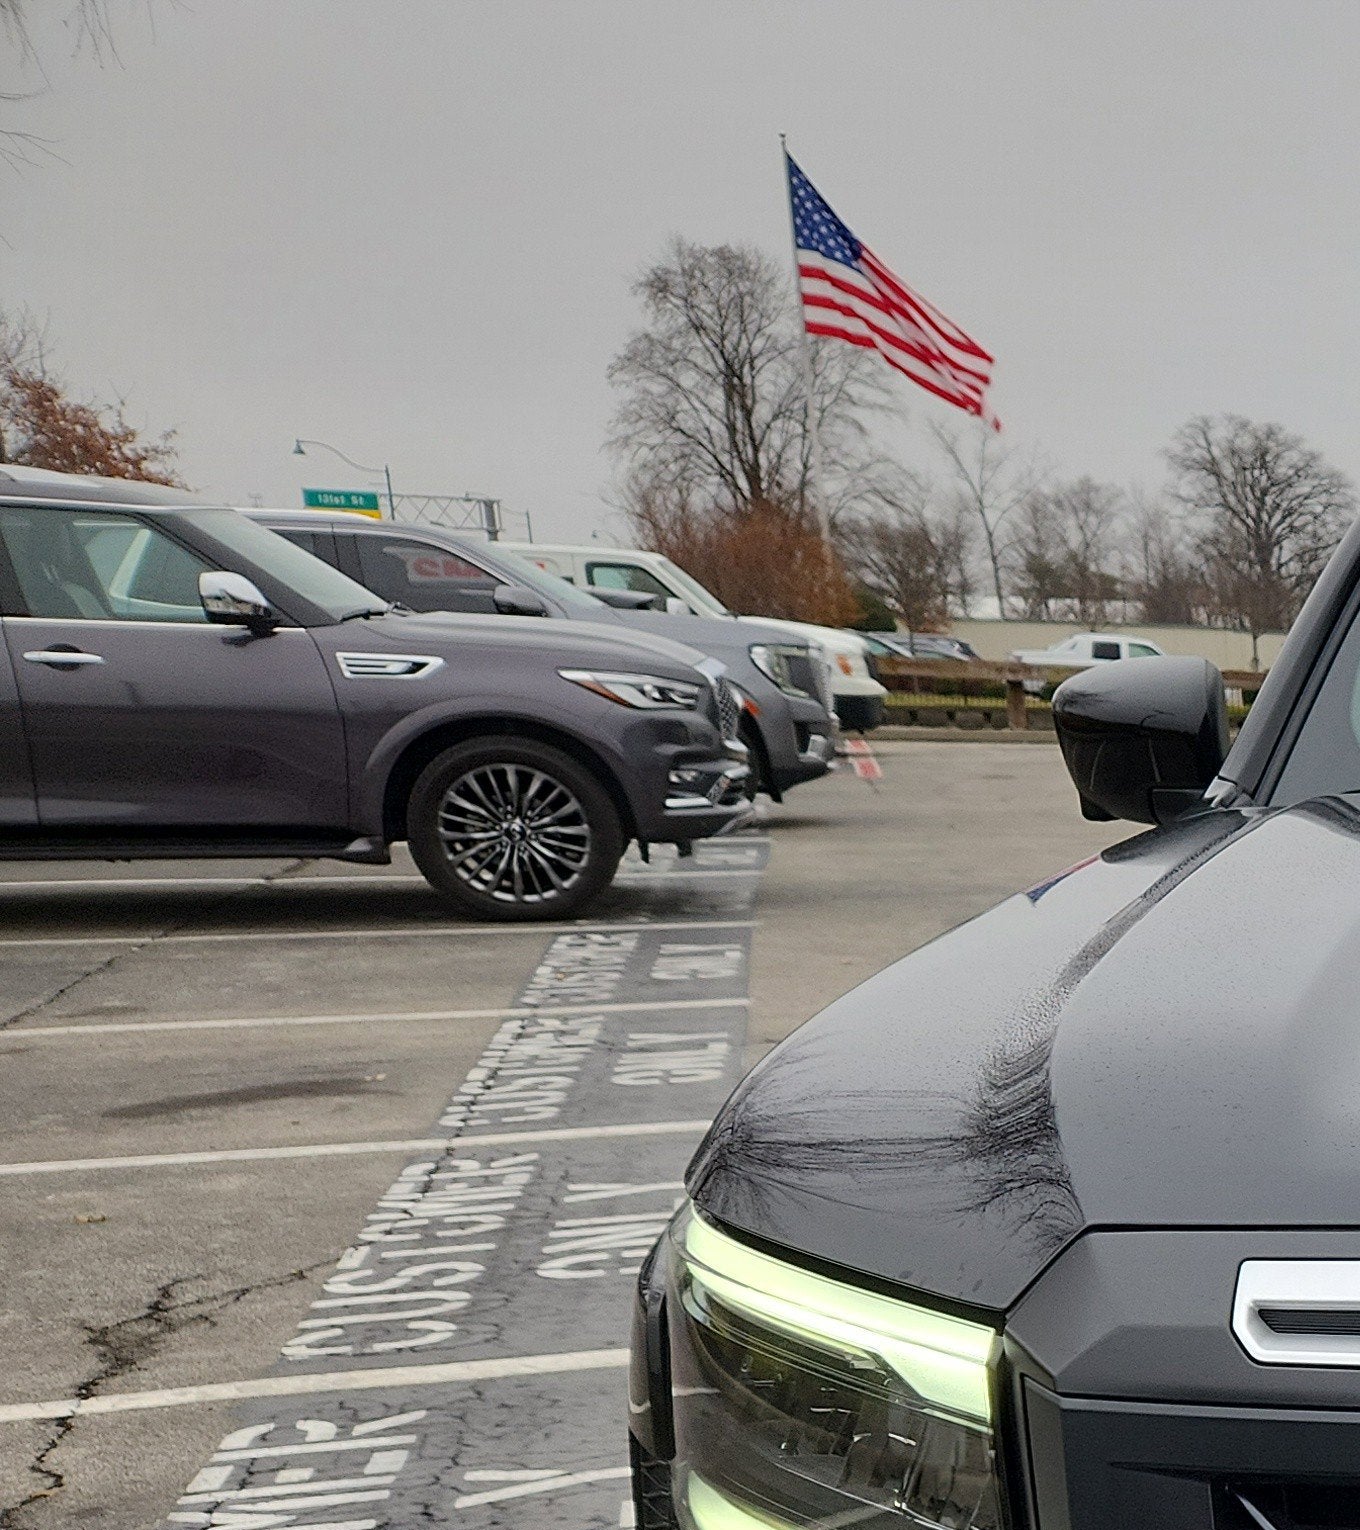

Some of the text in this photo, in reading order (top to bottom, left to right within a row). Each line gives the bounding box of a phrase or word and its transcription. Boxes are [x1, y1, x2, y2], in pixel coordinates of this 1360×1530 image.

[438, 1015, 604, 1127] CUSTOMER
[610, 1032, 730, 1085] ONLY
[281, 1152, 540, 1361] CUSTOMER
